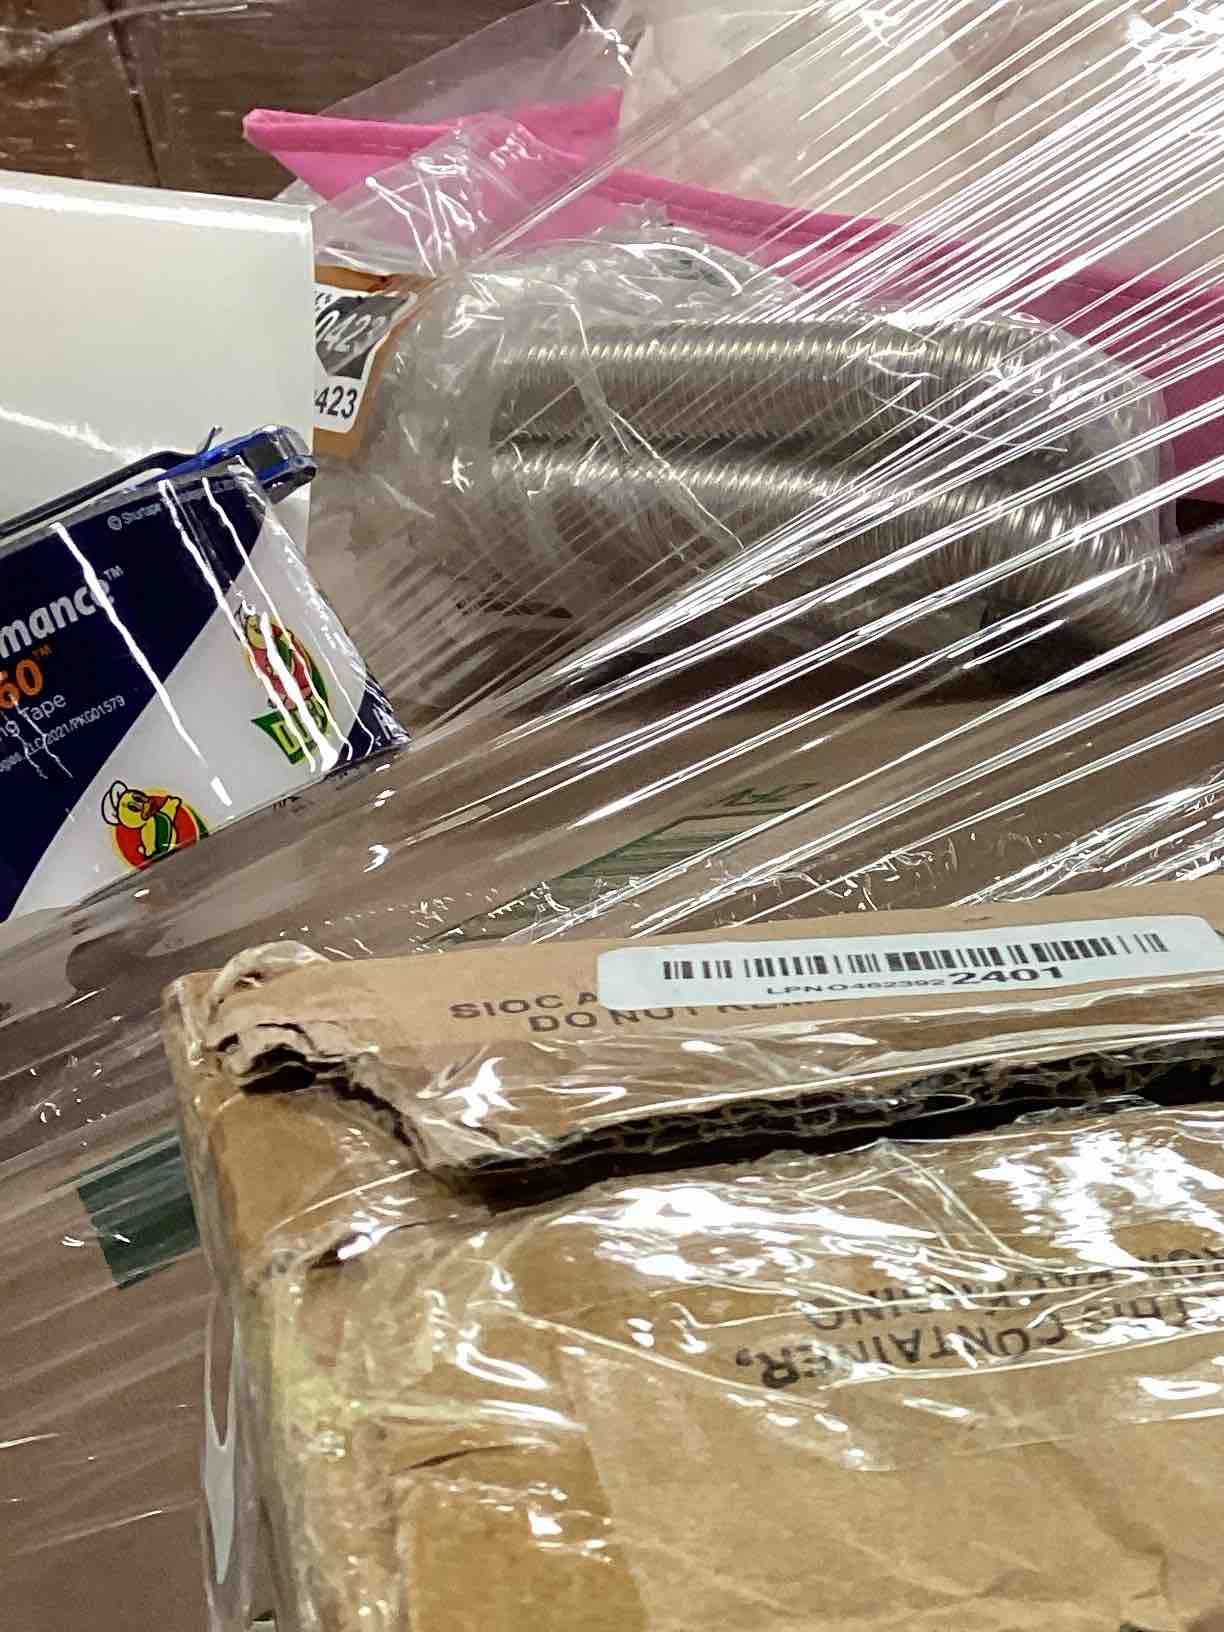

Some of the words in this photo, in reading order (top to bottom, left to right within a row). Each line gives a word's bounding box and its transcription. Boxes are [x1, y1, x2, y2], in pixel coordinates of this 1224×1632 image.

[315, 384, 358, 419] 423
[450, 994, 564, 1019] SIOC
[528, 1010, 599, 1033] DO
